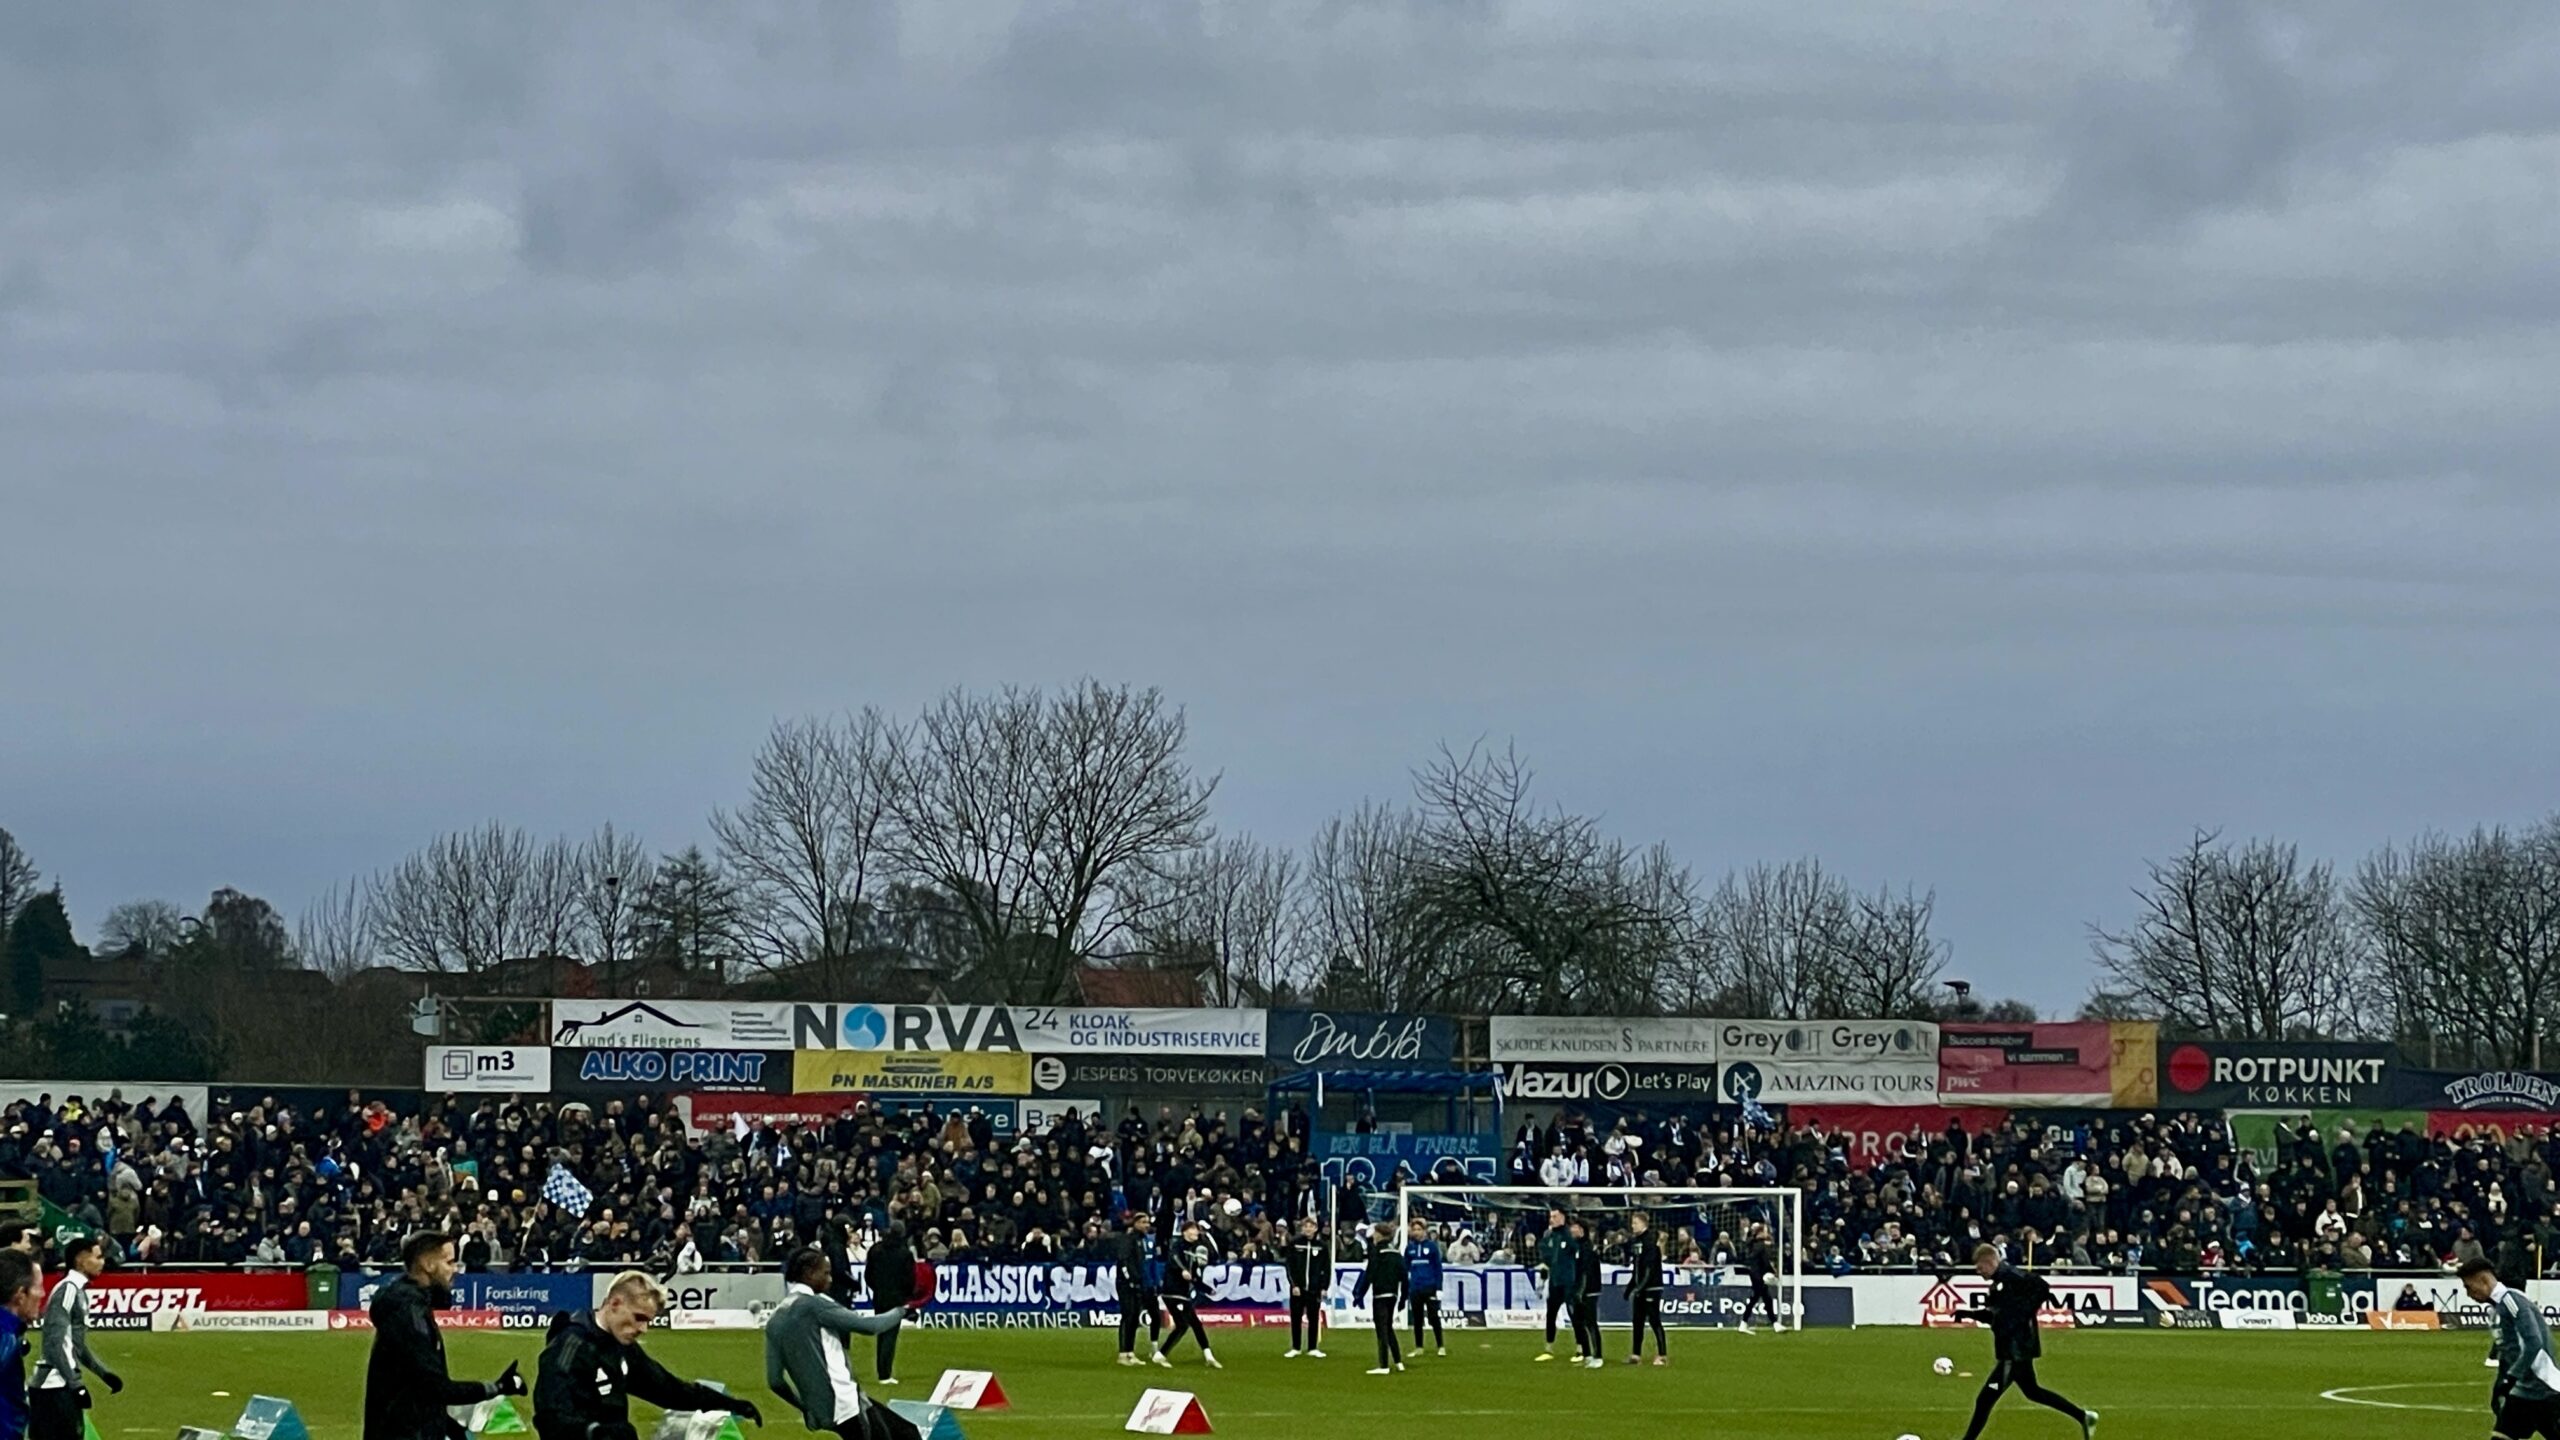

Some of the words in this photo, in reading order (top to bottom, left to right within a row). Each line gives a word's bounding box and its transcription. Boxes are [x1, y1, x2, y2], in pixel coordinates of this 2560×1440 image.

[793, 1004, 1024, 1051] NORVA
[1024, 1008, 1059, 1030] 24
[1069, 1014, 1135, 1030] KLOAK-
[631, 1034, 701, 1048] Fliserens
[1070, 1031, 1097, 1046] OG
[1104, 1031, 1261, 1048] INDUSTRISERVICE
[1496, 1038, 1546, 1052] SKJØDE
[1551, 1039, 1618, 1052] KNUDSEN
[1638, 1040, 1710, 1054] PARTNERE
[1722, 1025, 1784, 1056] Grey
[1831, 1026, 1893, 1055] Grey
[477, 1050, 515, 1071] m3
[580, 1051, 666, 1082] ALKO
[670, 1052, 767, 1083] PRINT
[1071, 1066, 1139, 1082] JESPERS
[1144, 1068, 1264, 1084] TORVEKØKKEN
[2214, 1057, 2386, 1084] ROTPUNKT
[831, 1075, 857, 1088] PN
[862, 1075, 958, 1089] MASKINER
[962, 1075, 994, 1089] A/S
[1493, 1063, 1594, 1099] Mazur
[1677, 1073, 1711, 1093] Play
[1769, 1075, 1865, 1092] AMAZING
[1870, 1075, 1934, 1092] TOURS
[1946, 1076, 1981, 1092] pwc
[2444, 1071, 2560, 1106] TROLDEN
[2247, 1086, 2352, 1104] KØKKEN
[84, 1288, 207, 1314] ENGEL
[485, 1286, 550, 1303] Forsikring
[88, 1316, 149, 1329] CARCLUB
[192, 1315, 315, 1328] AUTOCENTRALEN
[502, 1314, 534, 1328] DLO
[1089, 1309, 1123, 1327] Maz
